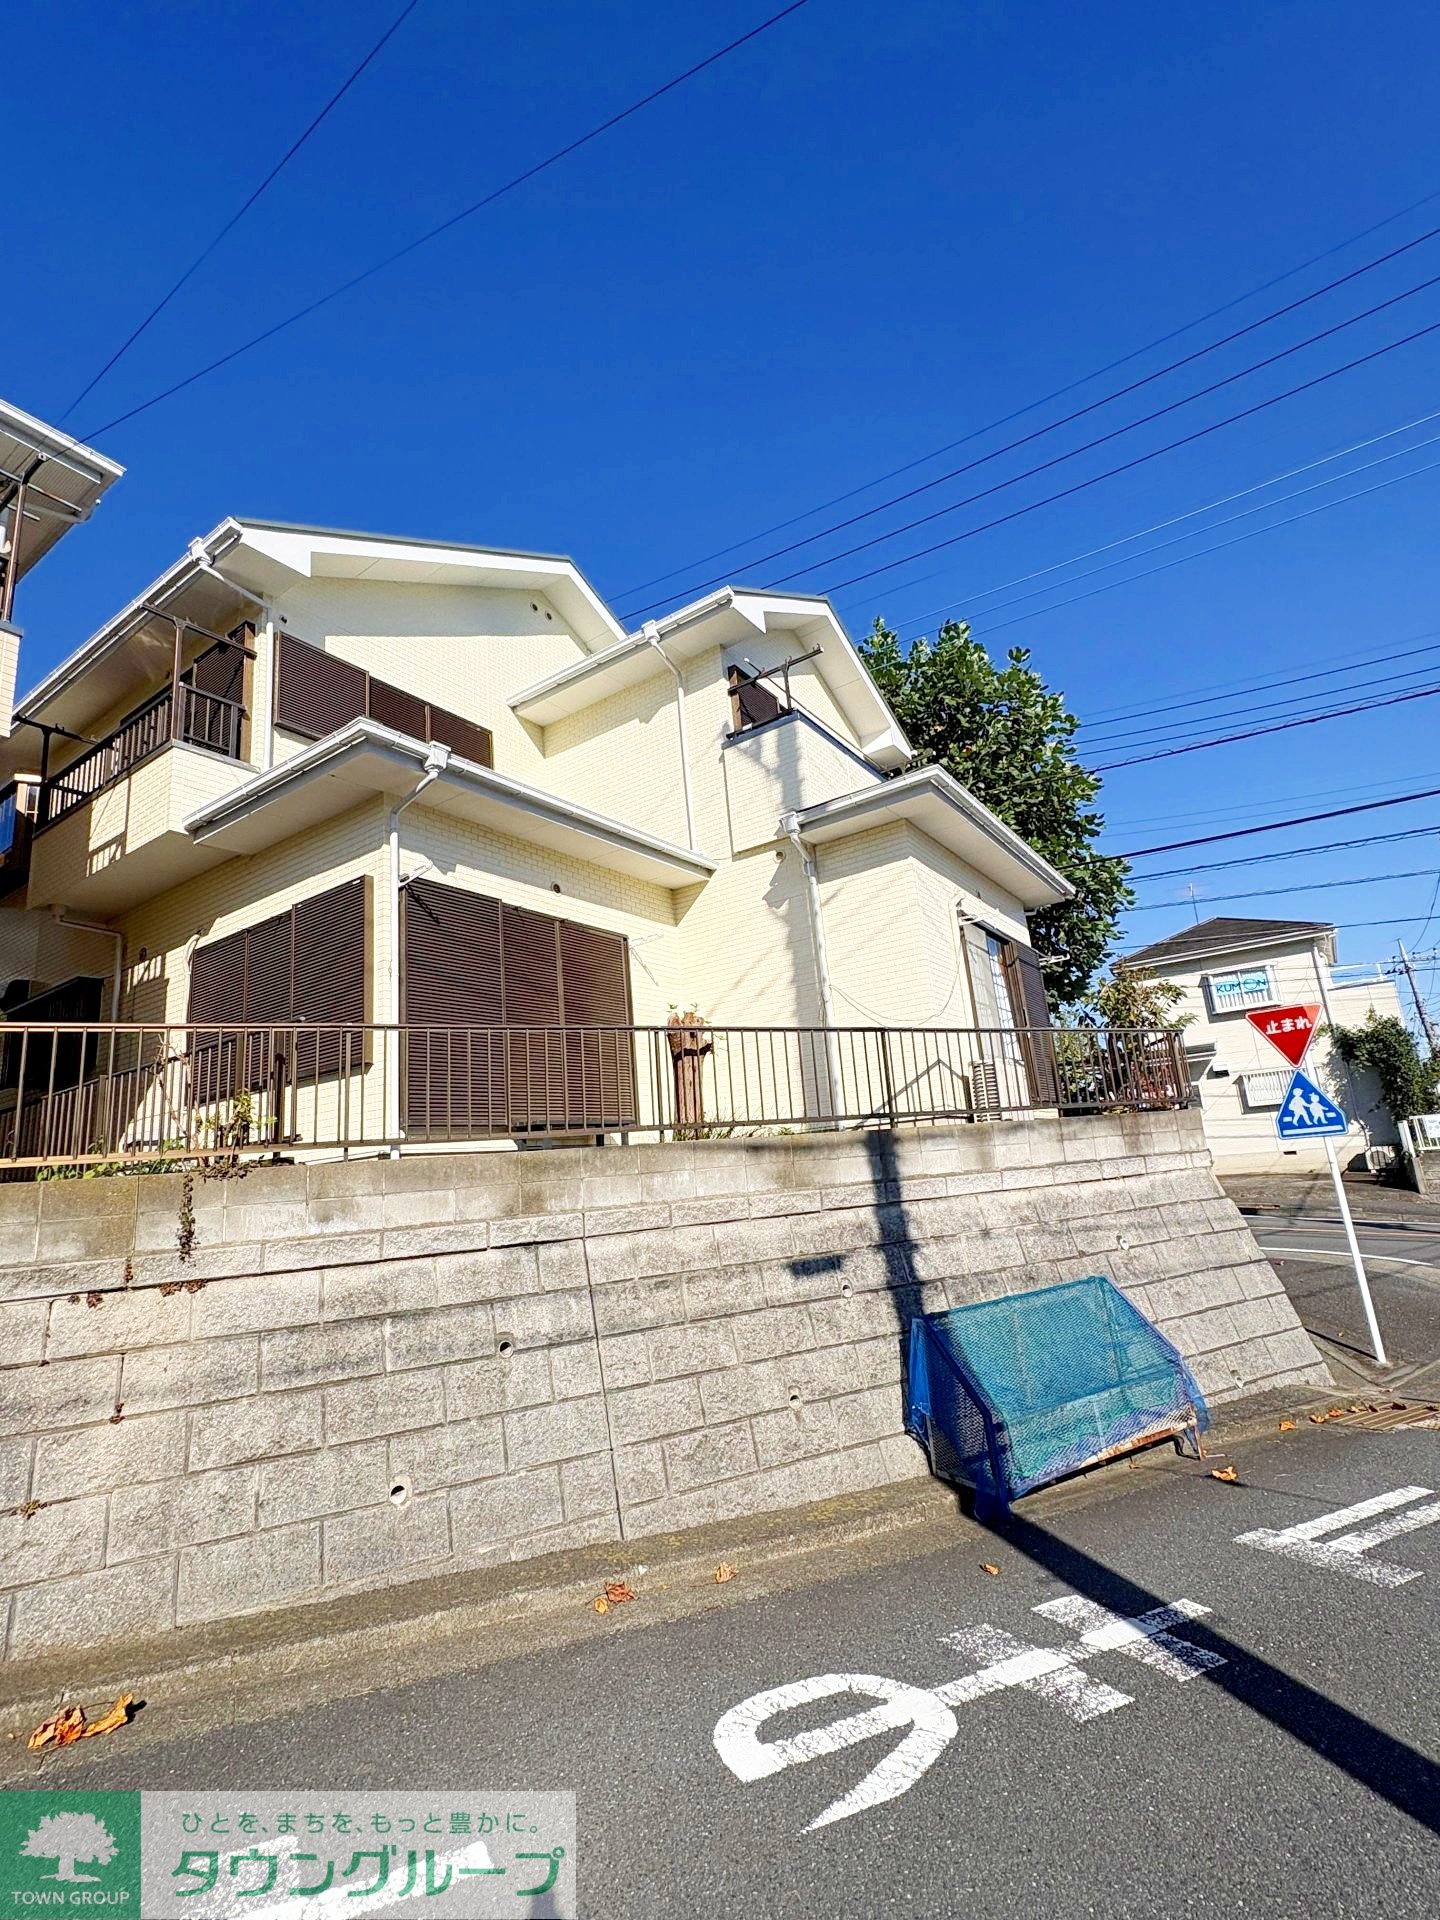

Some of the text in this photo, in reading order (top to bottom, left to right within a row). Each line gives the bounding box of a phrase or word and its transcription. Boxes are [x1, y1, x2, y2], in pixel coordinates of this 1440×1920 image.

[1216, 978, 1266, 993] KUMON
[1265, 1015, 1313, 1035] 止まれ
